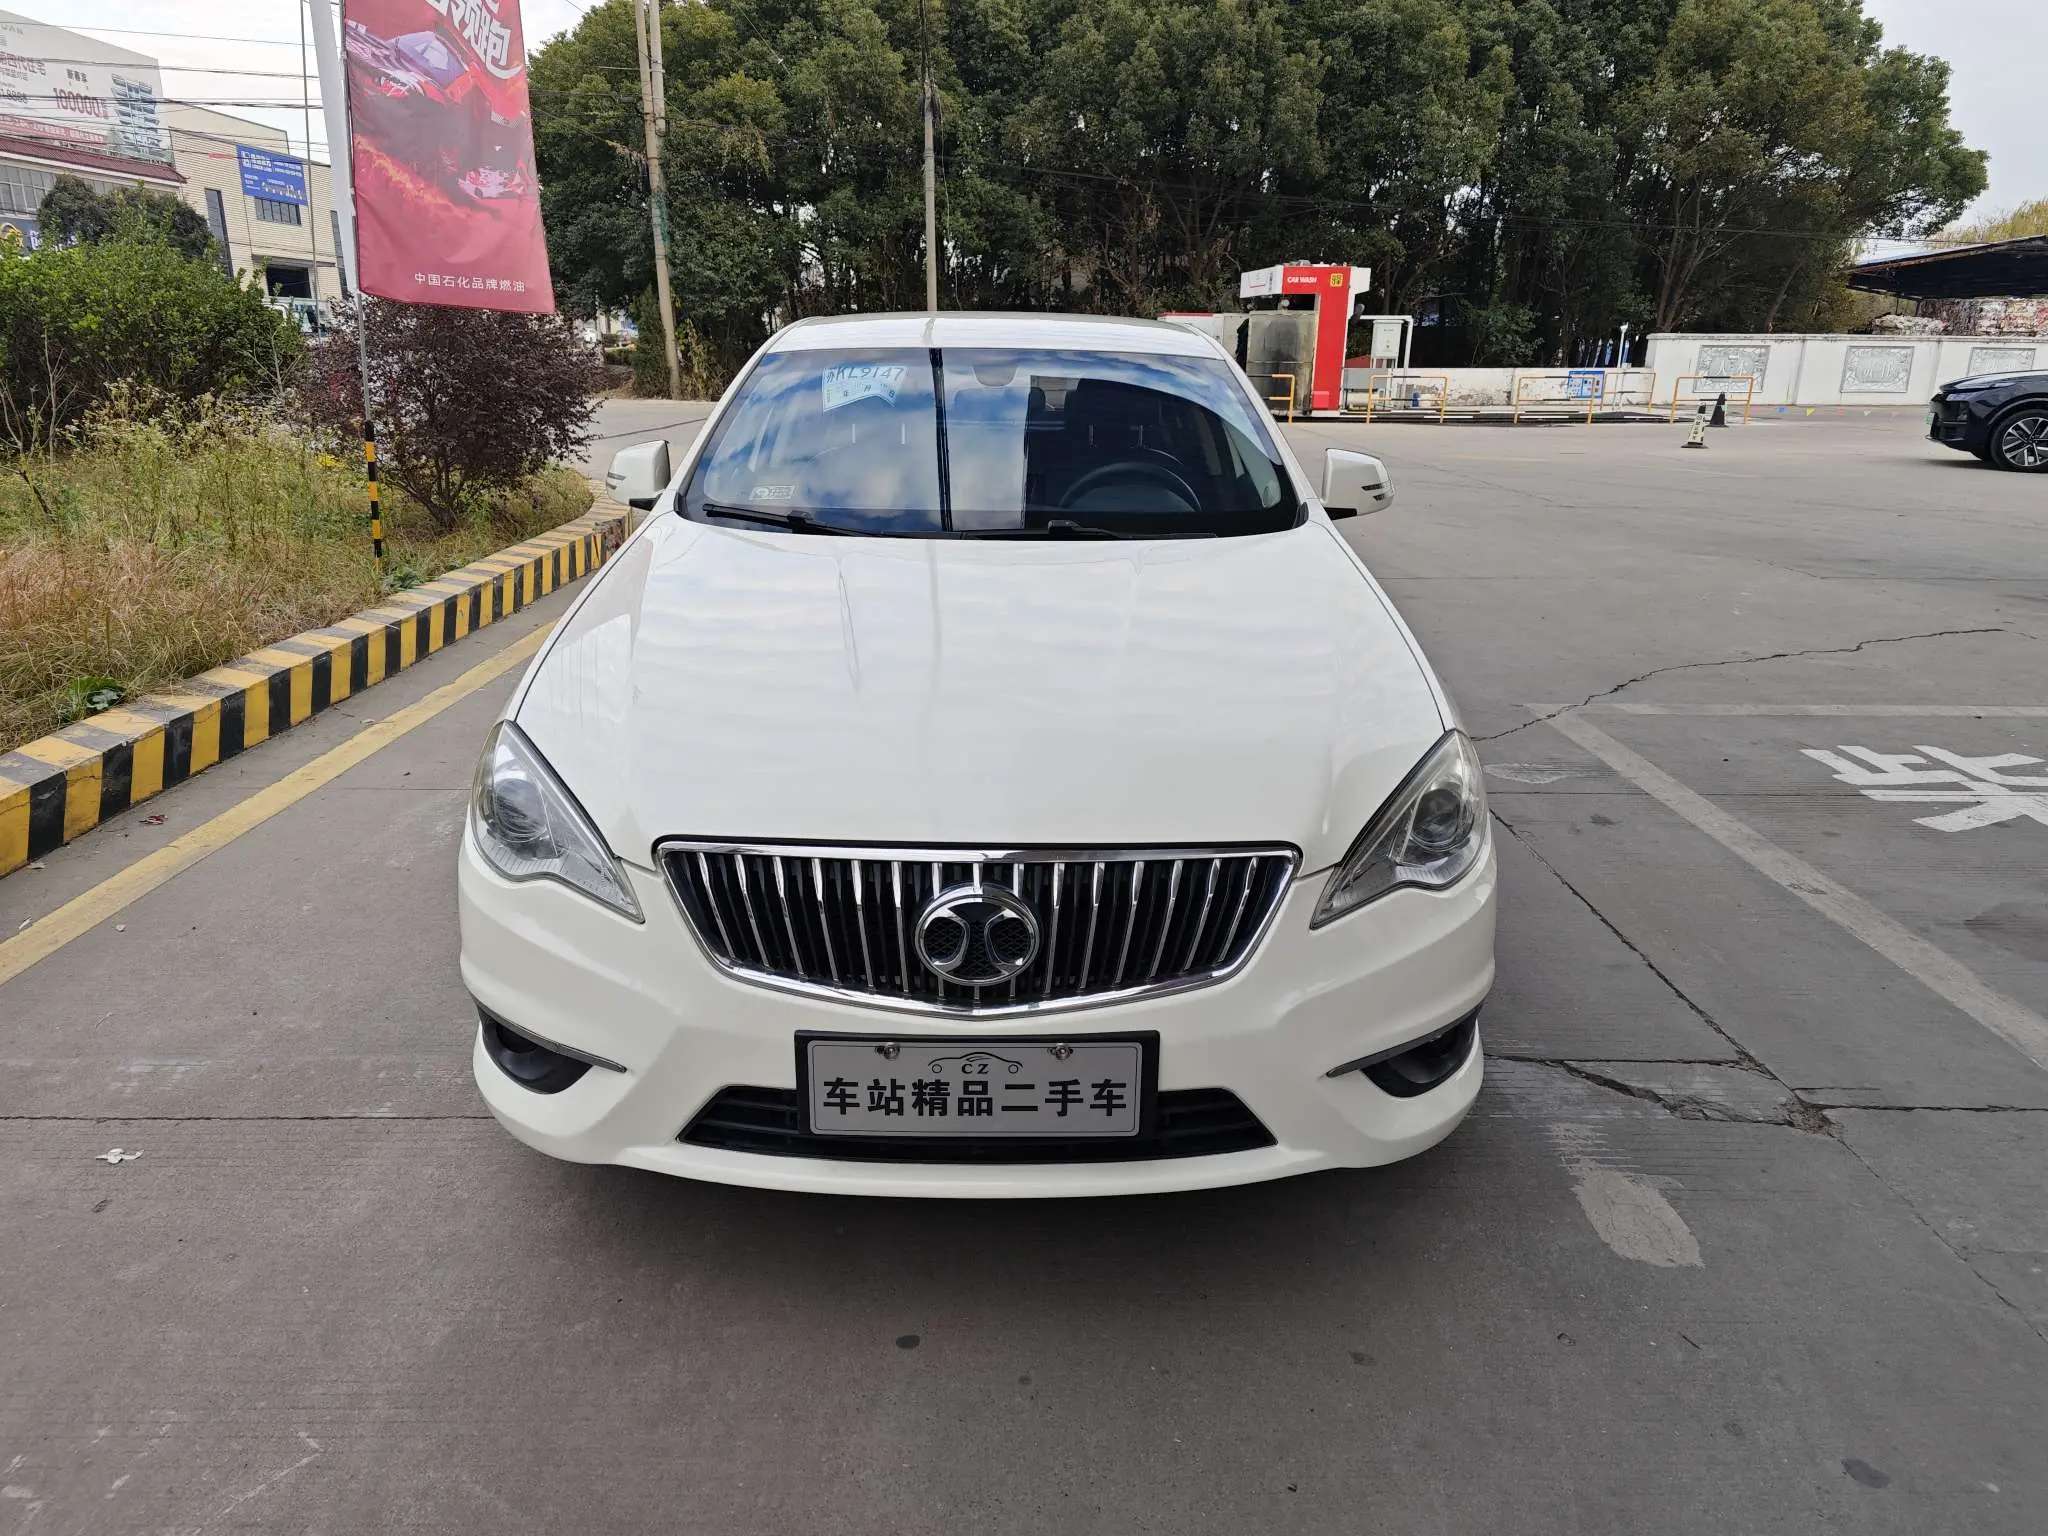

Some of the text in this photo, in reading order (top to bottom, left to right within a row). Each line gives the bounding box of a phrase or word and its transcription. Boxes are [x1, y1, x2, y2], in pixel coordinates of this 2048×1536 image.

[414, 271, 525, 292] 中国石化品牌燃油
[823, 1076, 1127, 1117] 车站精品二手车
